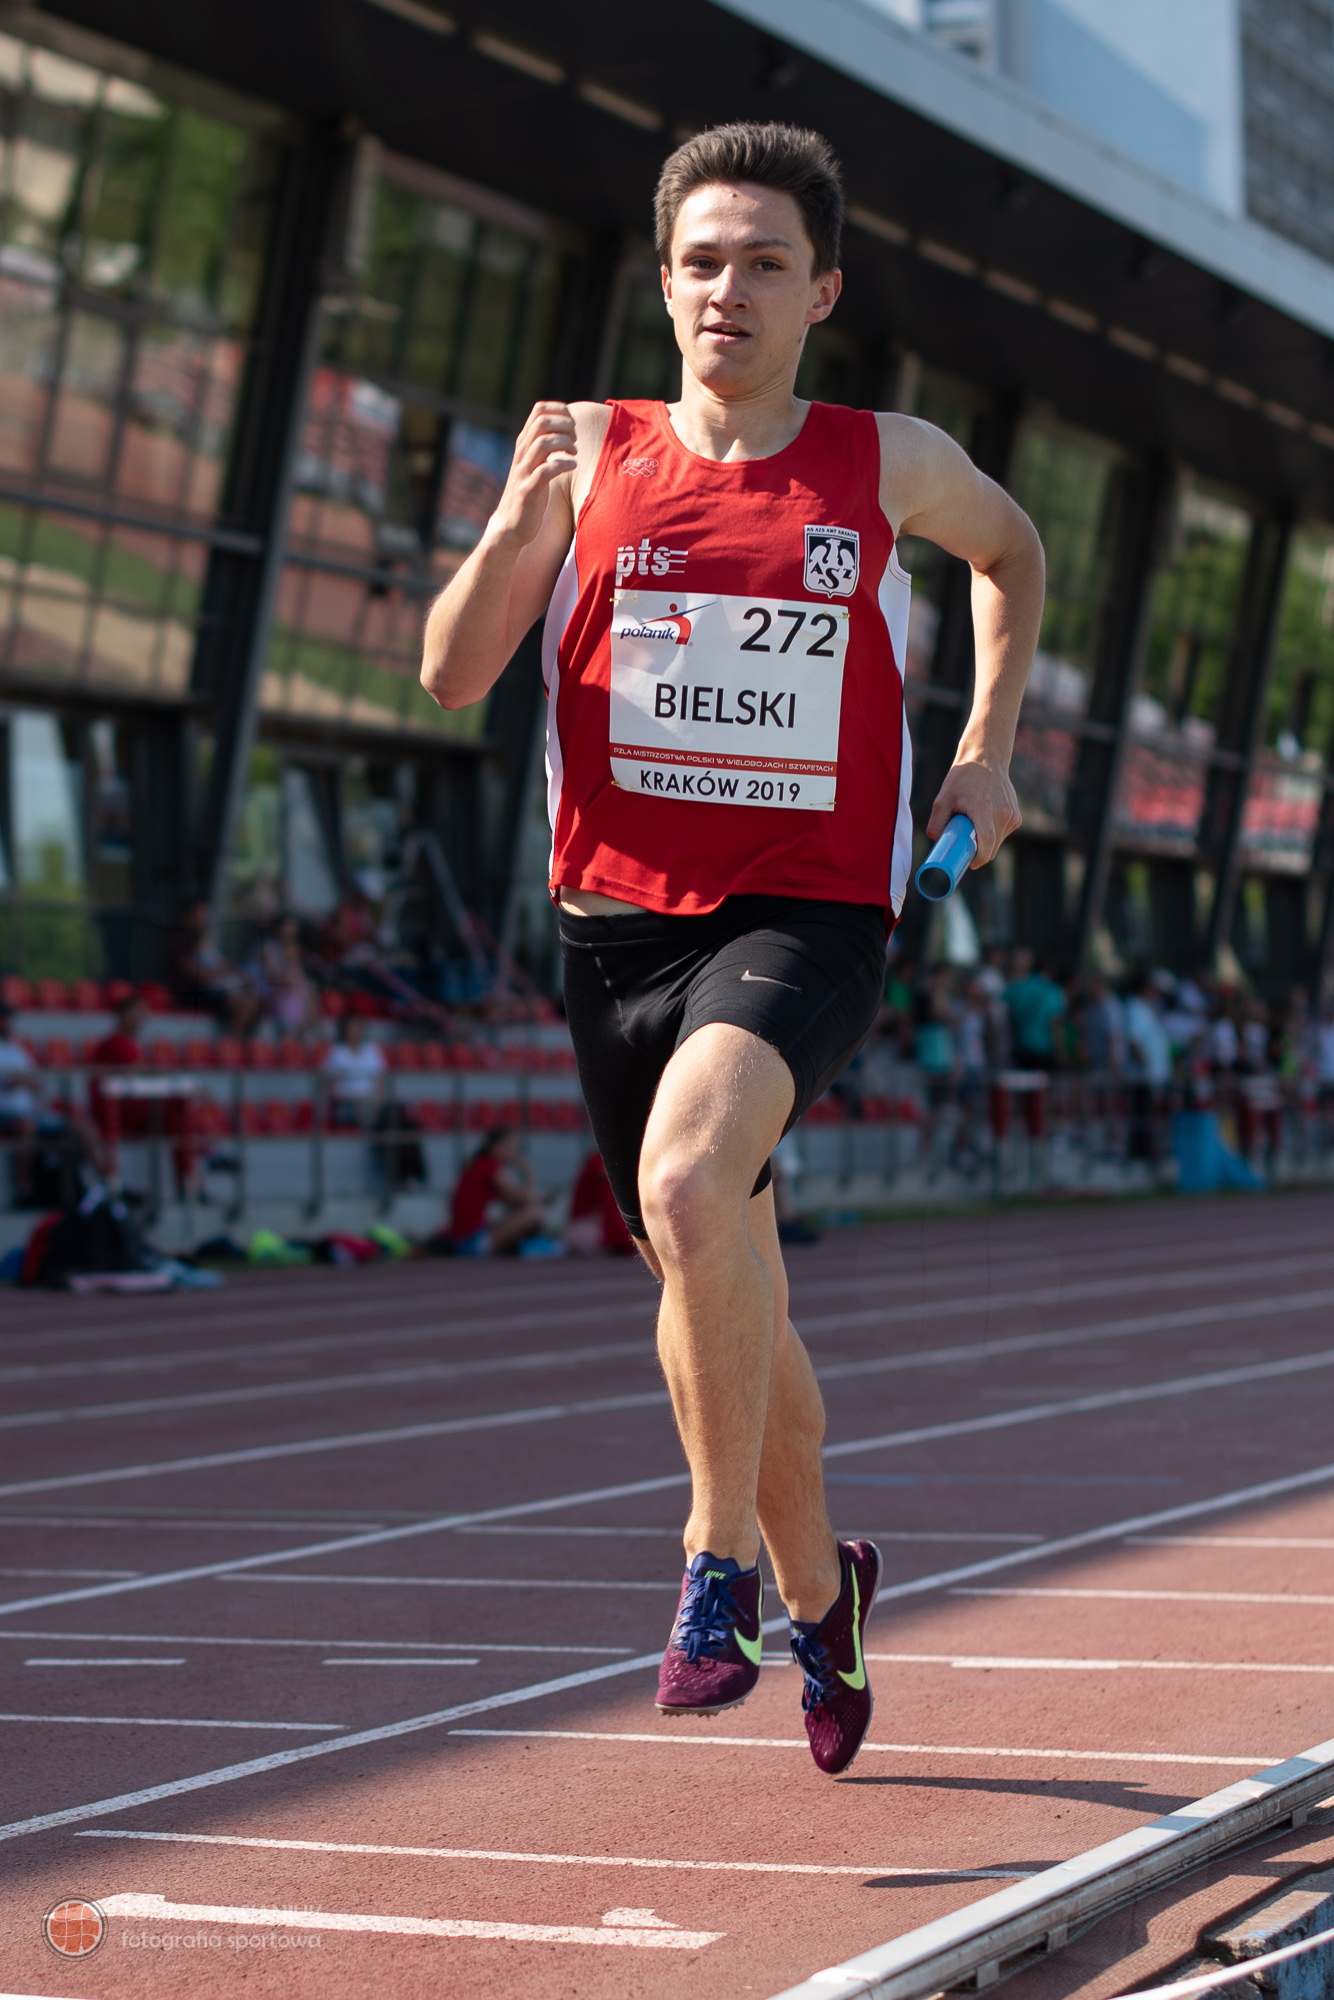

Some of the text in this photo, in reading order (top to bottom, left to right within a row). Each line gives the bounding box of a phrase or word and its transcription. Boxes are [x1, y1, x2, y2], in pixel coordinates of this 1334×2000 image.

[615, 538, 673, 587] pts
[620, 626, 676, 640] polanik
[740, 606, 838, 658] 272
[654, 682, 796, 729] BIELSKI
[613, 746, 632, 756] PZLA
[633, 749, 686, 762] MISTRZOSTWA
[686, 755, 715, 764] POLSKI
[726, 759, 783, 769] WIELOBOJACH
[788, 763, 834, 773] SZTAFETACH
[640, 769, 801, 802] KRAKÓW 2019
